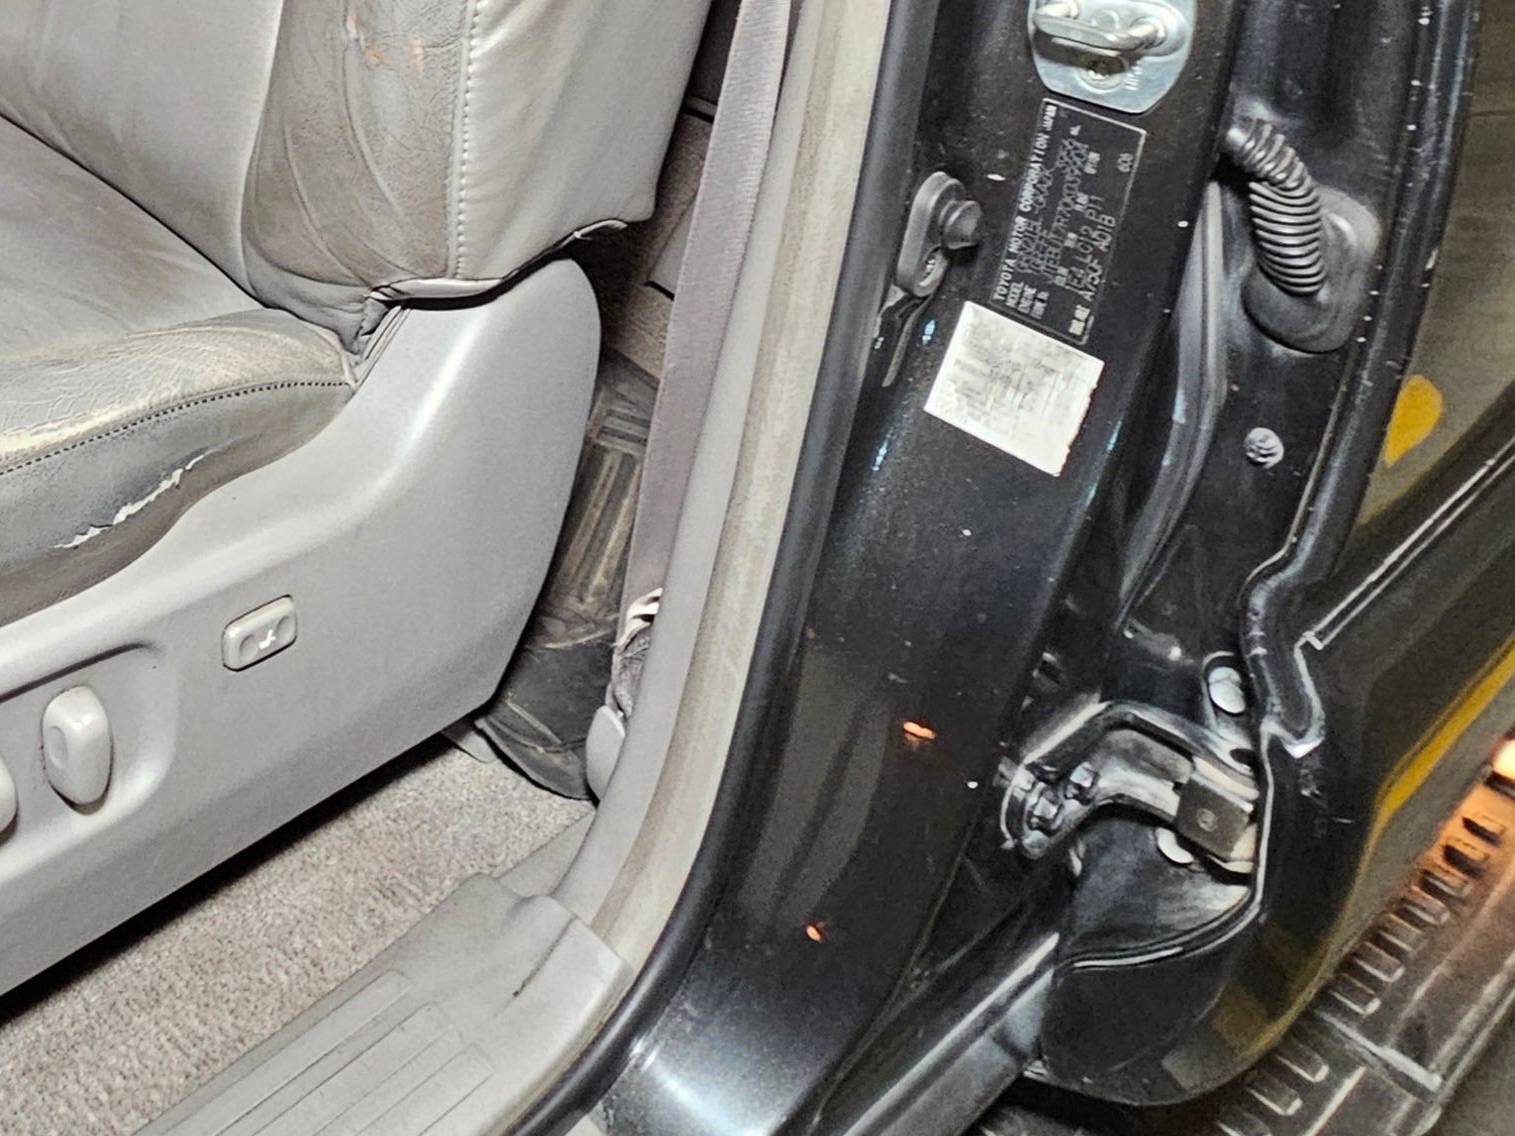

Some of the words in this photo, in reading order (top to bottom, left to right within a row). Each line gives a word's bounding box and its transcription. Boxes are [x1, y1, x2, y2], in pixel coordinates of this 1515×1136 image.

[993, 258, 1016, 301] TOYOTA
[1009, 216, 1027, 253] MOTOR
[1018, 133, 1050, 212] CORPORATION
[1043, 104, 1057, 131] JAPAN
